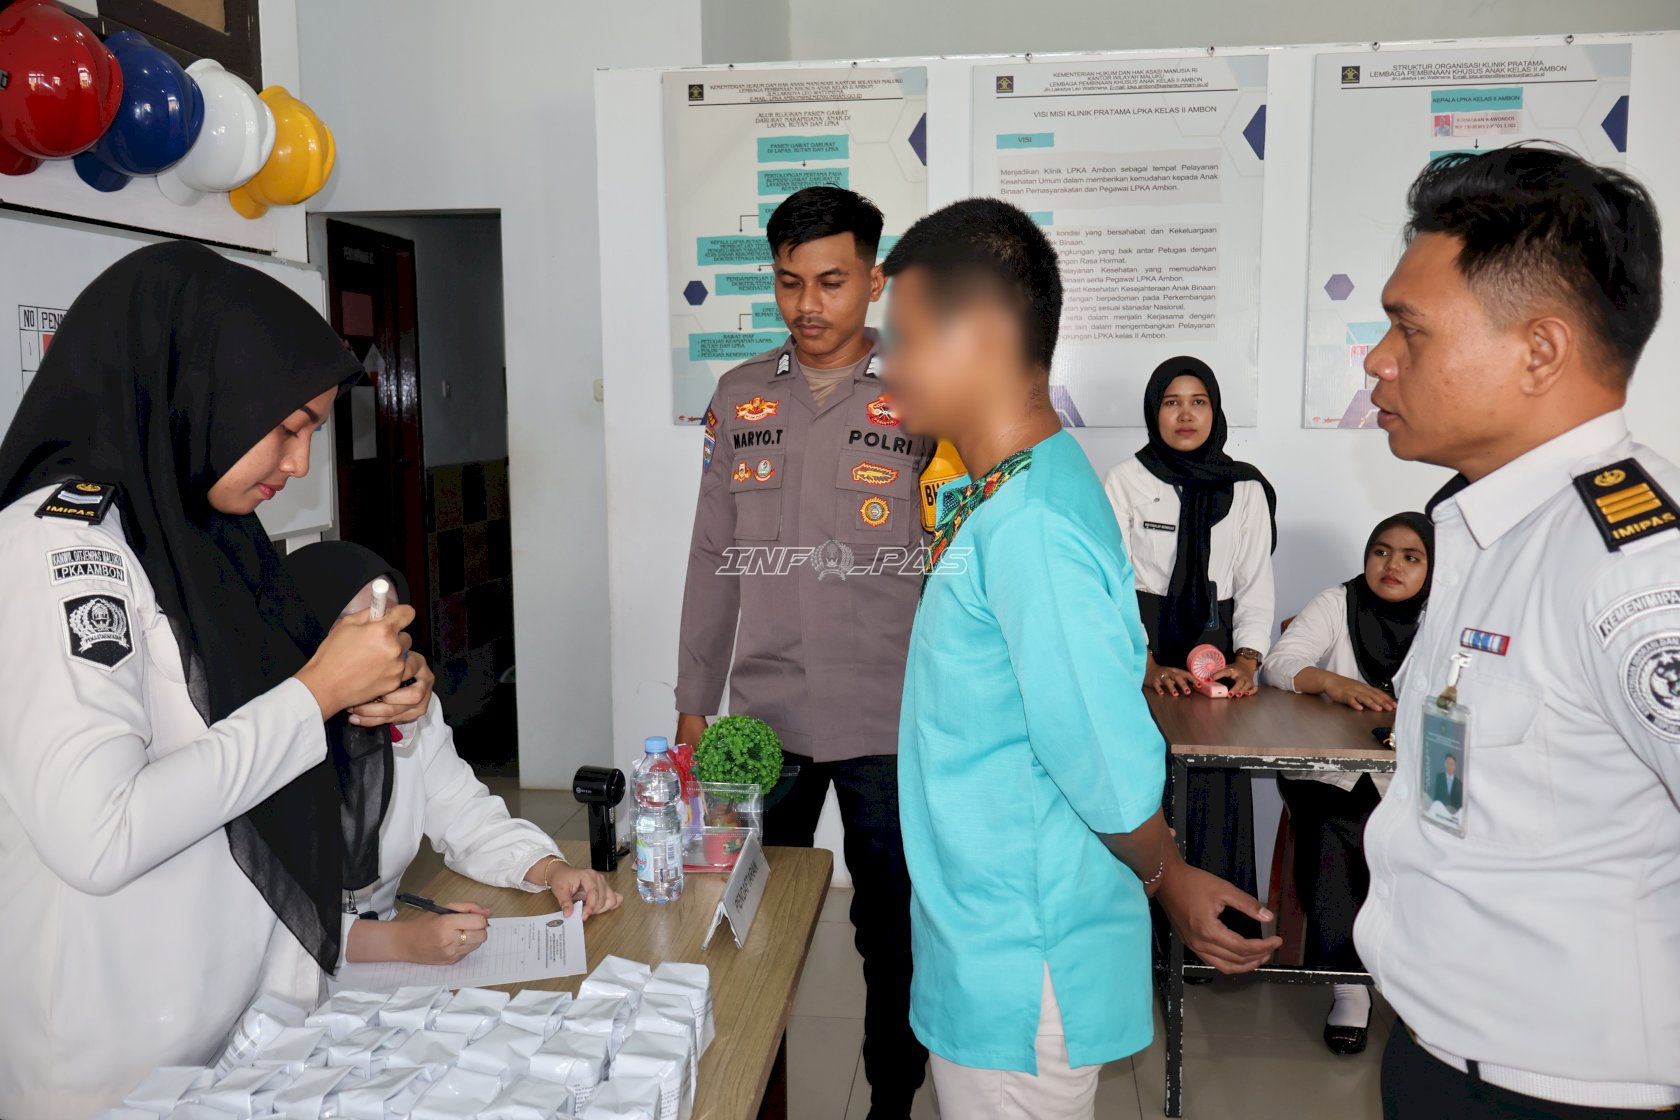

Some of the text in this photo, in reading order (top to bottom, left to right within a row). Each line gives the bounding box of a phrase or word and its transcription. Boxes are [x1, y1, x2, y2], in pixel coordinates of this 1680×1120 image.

[1392, 63, 1432, 71] STRUKTUR
[1033, 111, 1049, 119] VISI
[1050, 110, 1066, 118] MISI
[1094, 109, 1131, 117] PRATAMA
[1154, 107, 1180, 115] KELAS
[1000, 168, 1040, 177] Menjadikan
[1120, 165, 1148, 174] sebagai
[1152, 165, 1176, 173] tempat
[1181, 164, 1219, 173] Pelayanan
[1172, 174, 1198, 182] kepada
[1025, 186, 1083, 196] Pemasyarakatan
[1100, 185, 1129, 194] Pegawai
[1168, 227, 1217, 235] Kekeluargaan
[1158, 247, 1187, 255] Petugas
[1105, 276, 1135, 284] Pegawai
[1120, 285, 1170, 293] Kesejahteraan
[1096, 295, 1140, 303] berpedoman
[1163, 294, 1216, 302] Perkembangan
[23, 309, 35, 327] NO
[1188, 313, 1216, 321] dengan
[1115, 323, 1174, 331] mengembangkan
[1178, 322, 1216, 330] Pelayanan
[733, 429, 783, 449] MARYO.T
[848, 430, 913, 455] POLRI
[46, 505, 95, 517] IMIPAS
[1612, 513, 1677, 541] IMIPAS
[55, 563, 124, 581] LPKA AMBON
